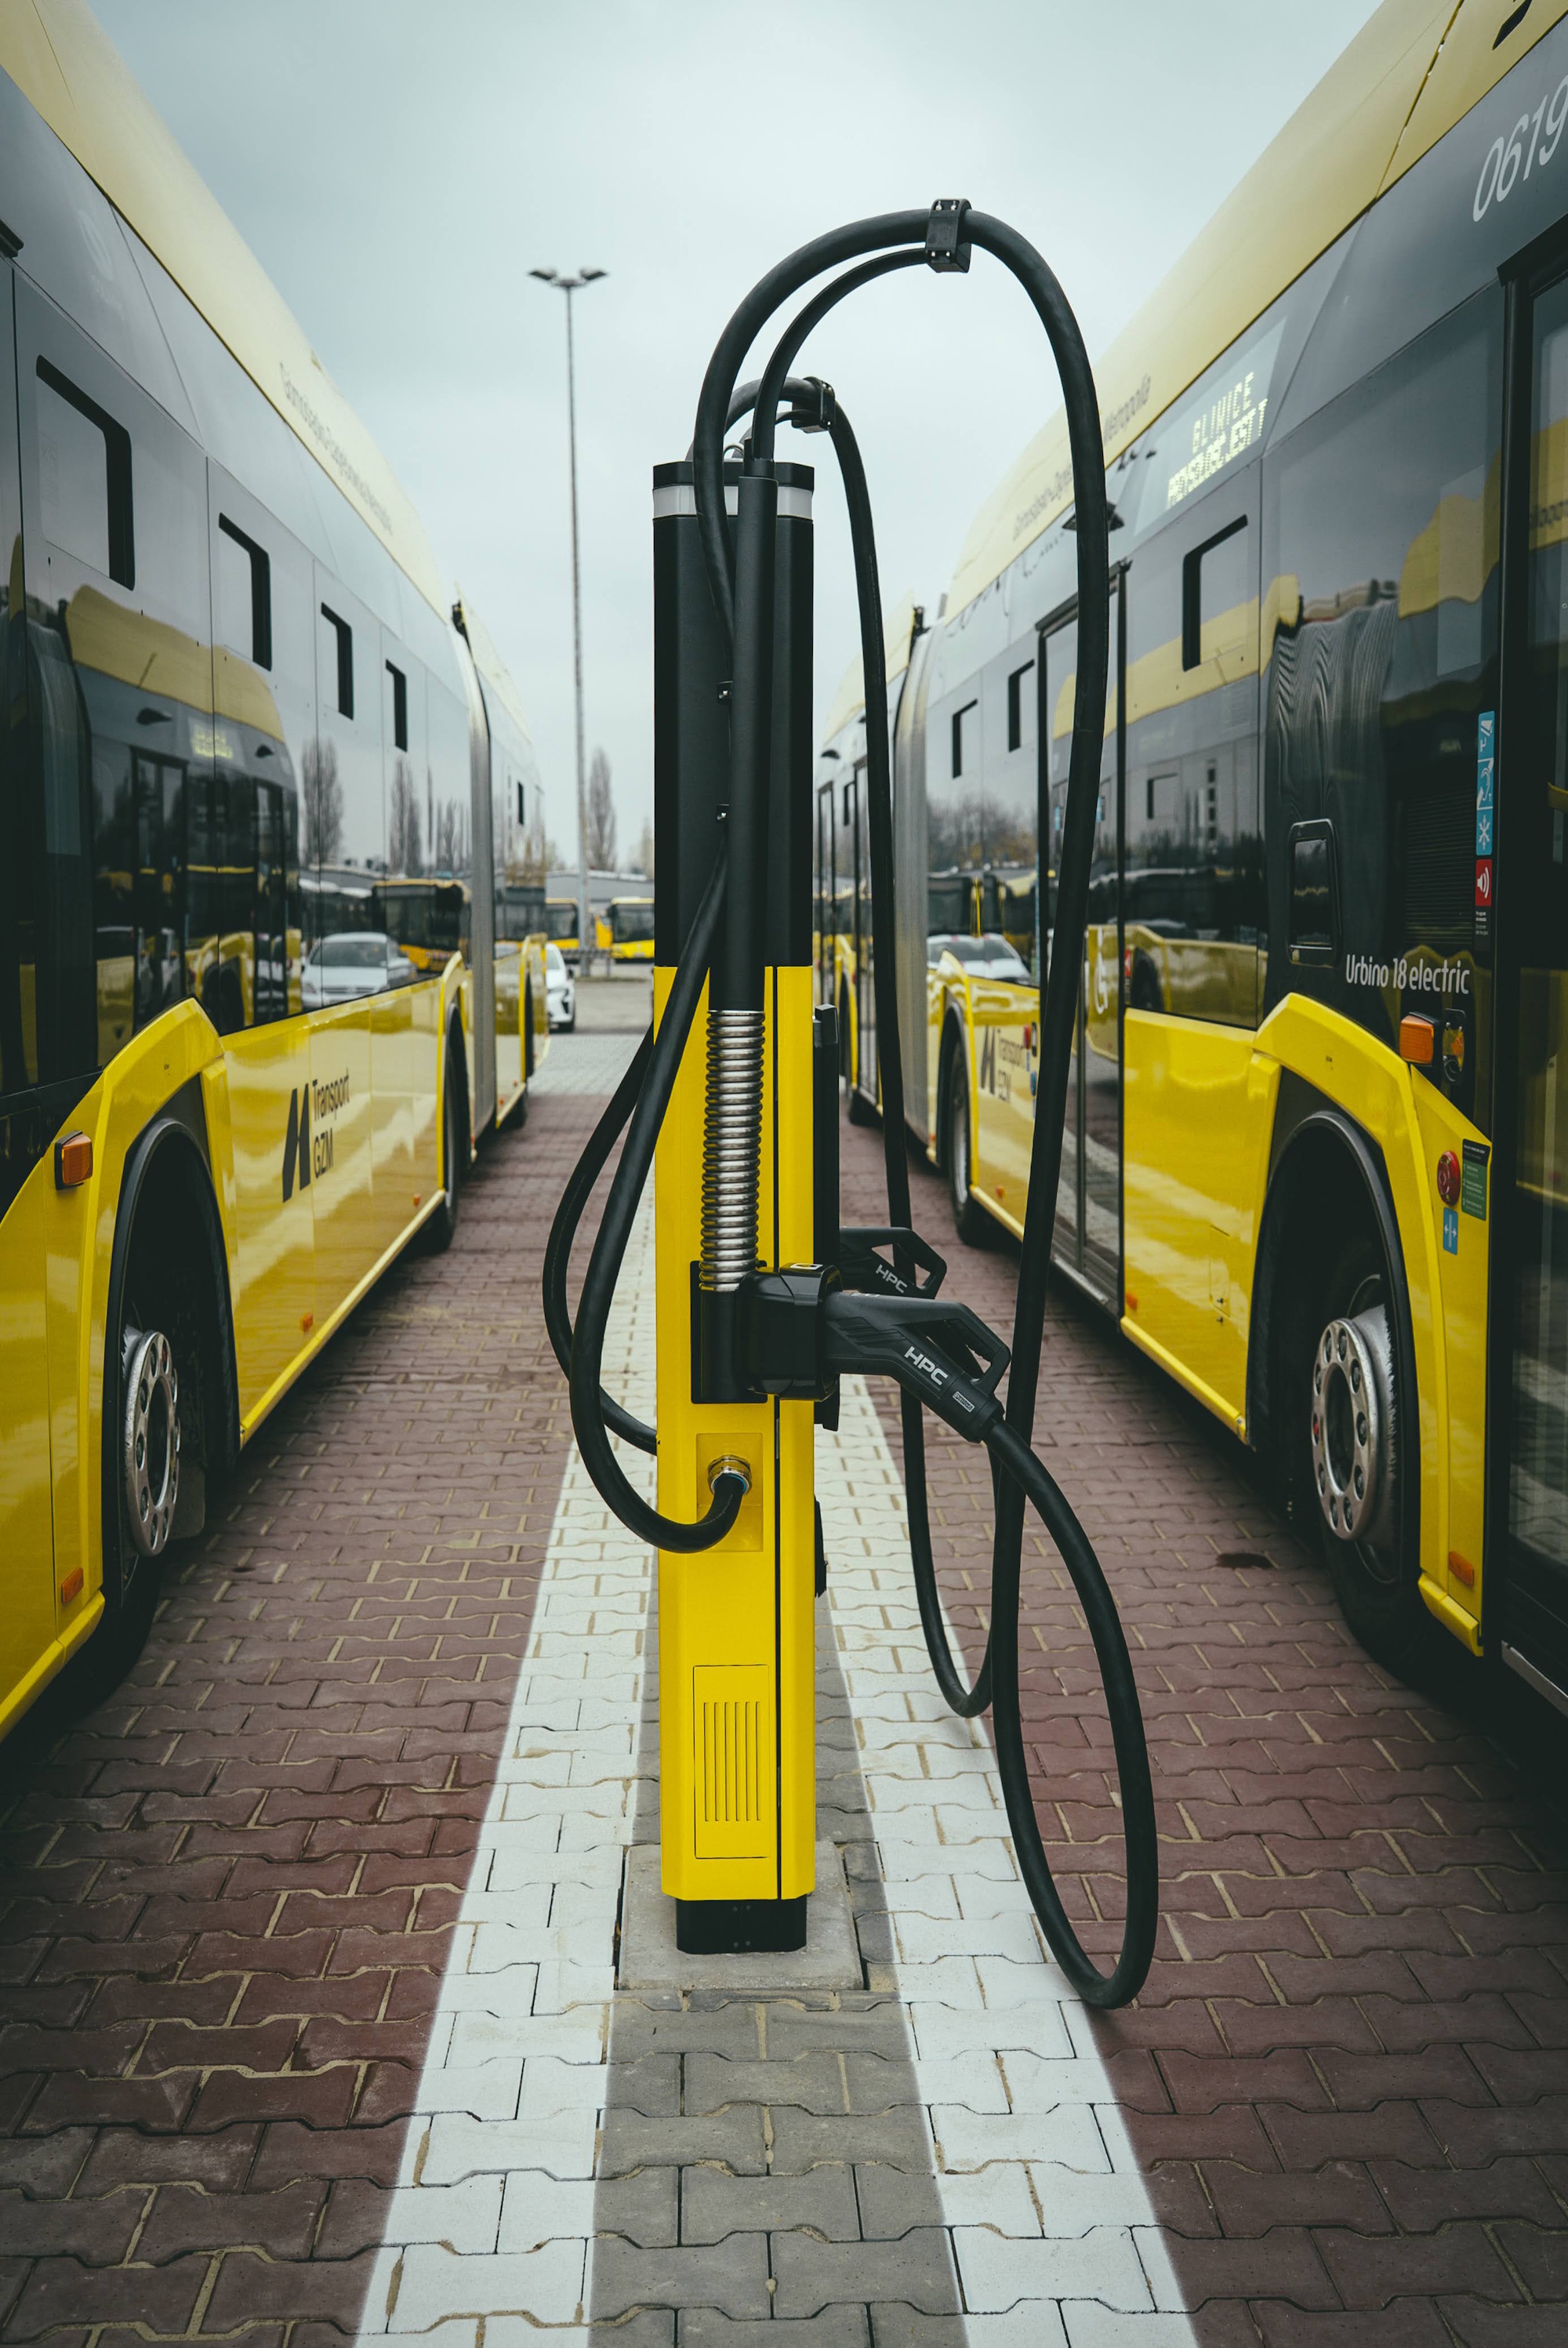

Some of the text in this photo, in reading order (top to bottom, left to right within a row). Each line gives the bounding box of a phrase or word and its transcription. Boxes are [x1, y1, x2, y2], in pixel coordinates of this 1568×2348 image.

[1472, 74, 1568, 222] 0619
[1192, 371, 1254, 454] GLIWICE
[1345, 953, 1470, 995] Urbino 18 electric
[312, 1066, 350, 1122] Transport
[314, 1127, 334, 1180] GZM
[875, 1264, 908, 1294] HPC
[904, 1346, 949, 1385] HPC
